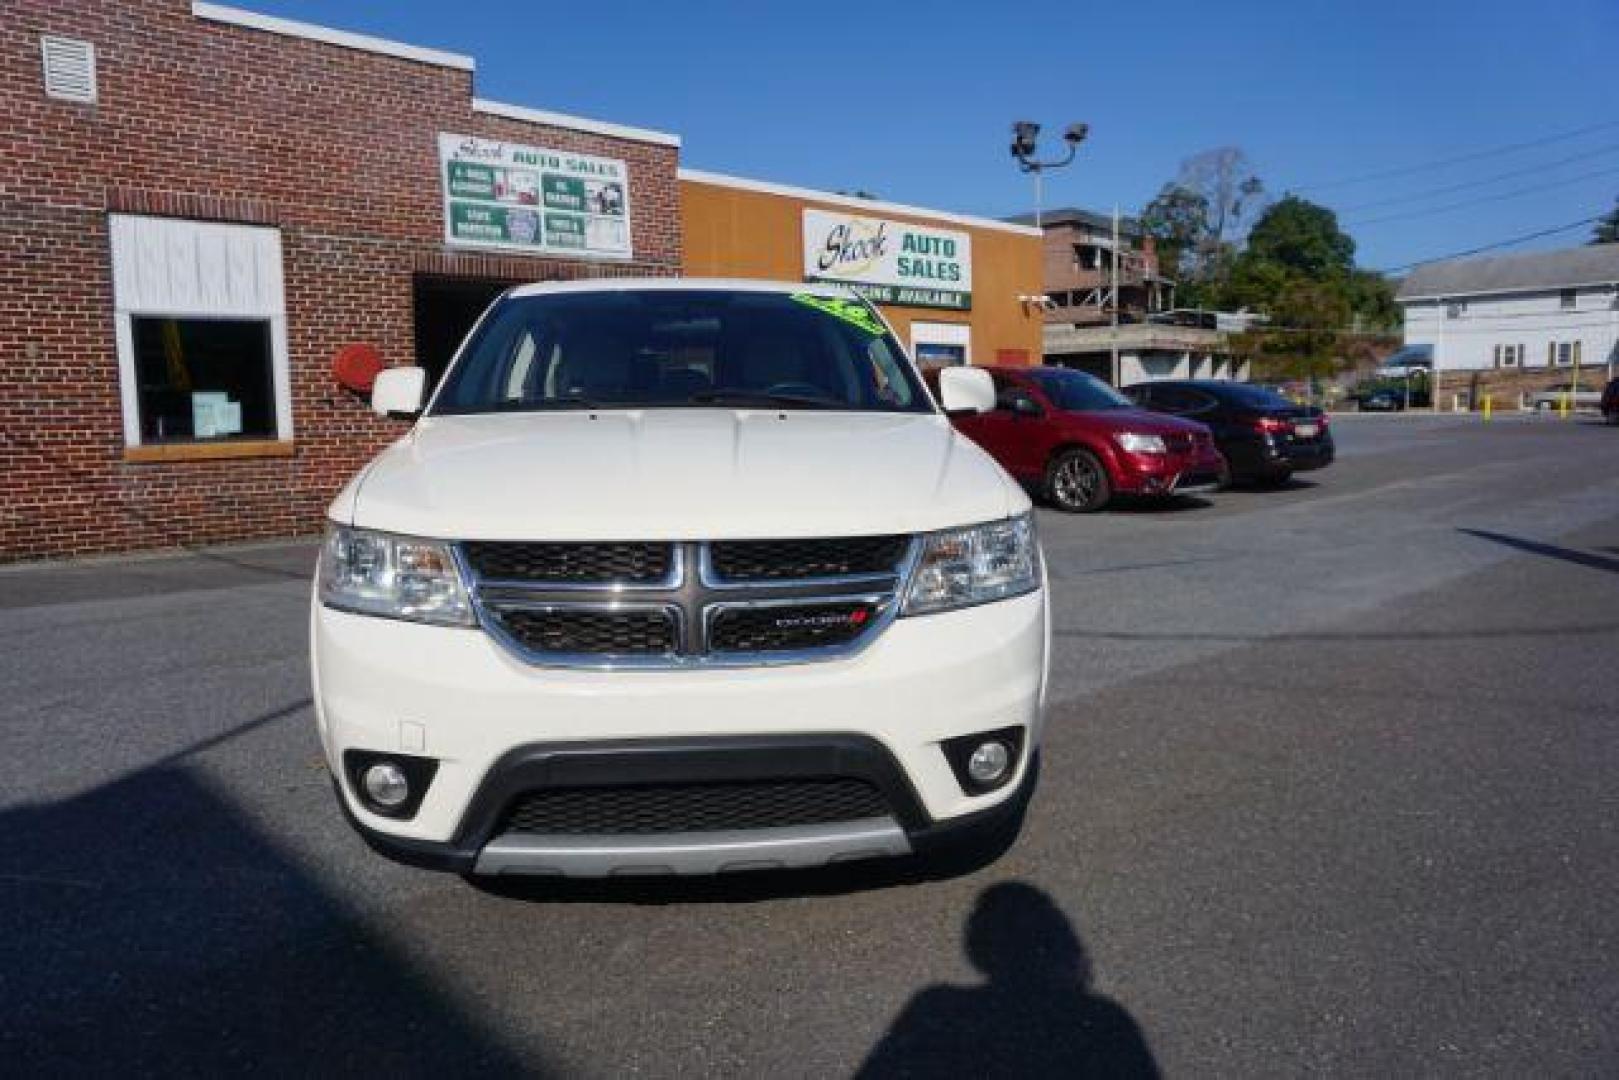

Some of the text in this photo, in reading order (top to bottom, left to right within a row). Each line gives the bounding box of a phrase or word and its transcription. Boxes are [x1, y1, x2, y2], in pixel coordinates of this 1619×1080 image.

[513, 150, 560, 168] AUTO
[566, 158, 618, 176] SALES
[902, 231, 956, 258] AUTO
[897, 257, 960, 281] SALES
